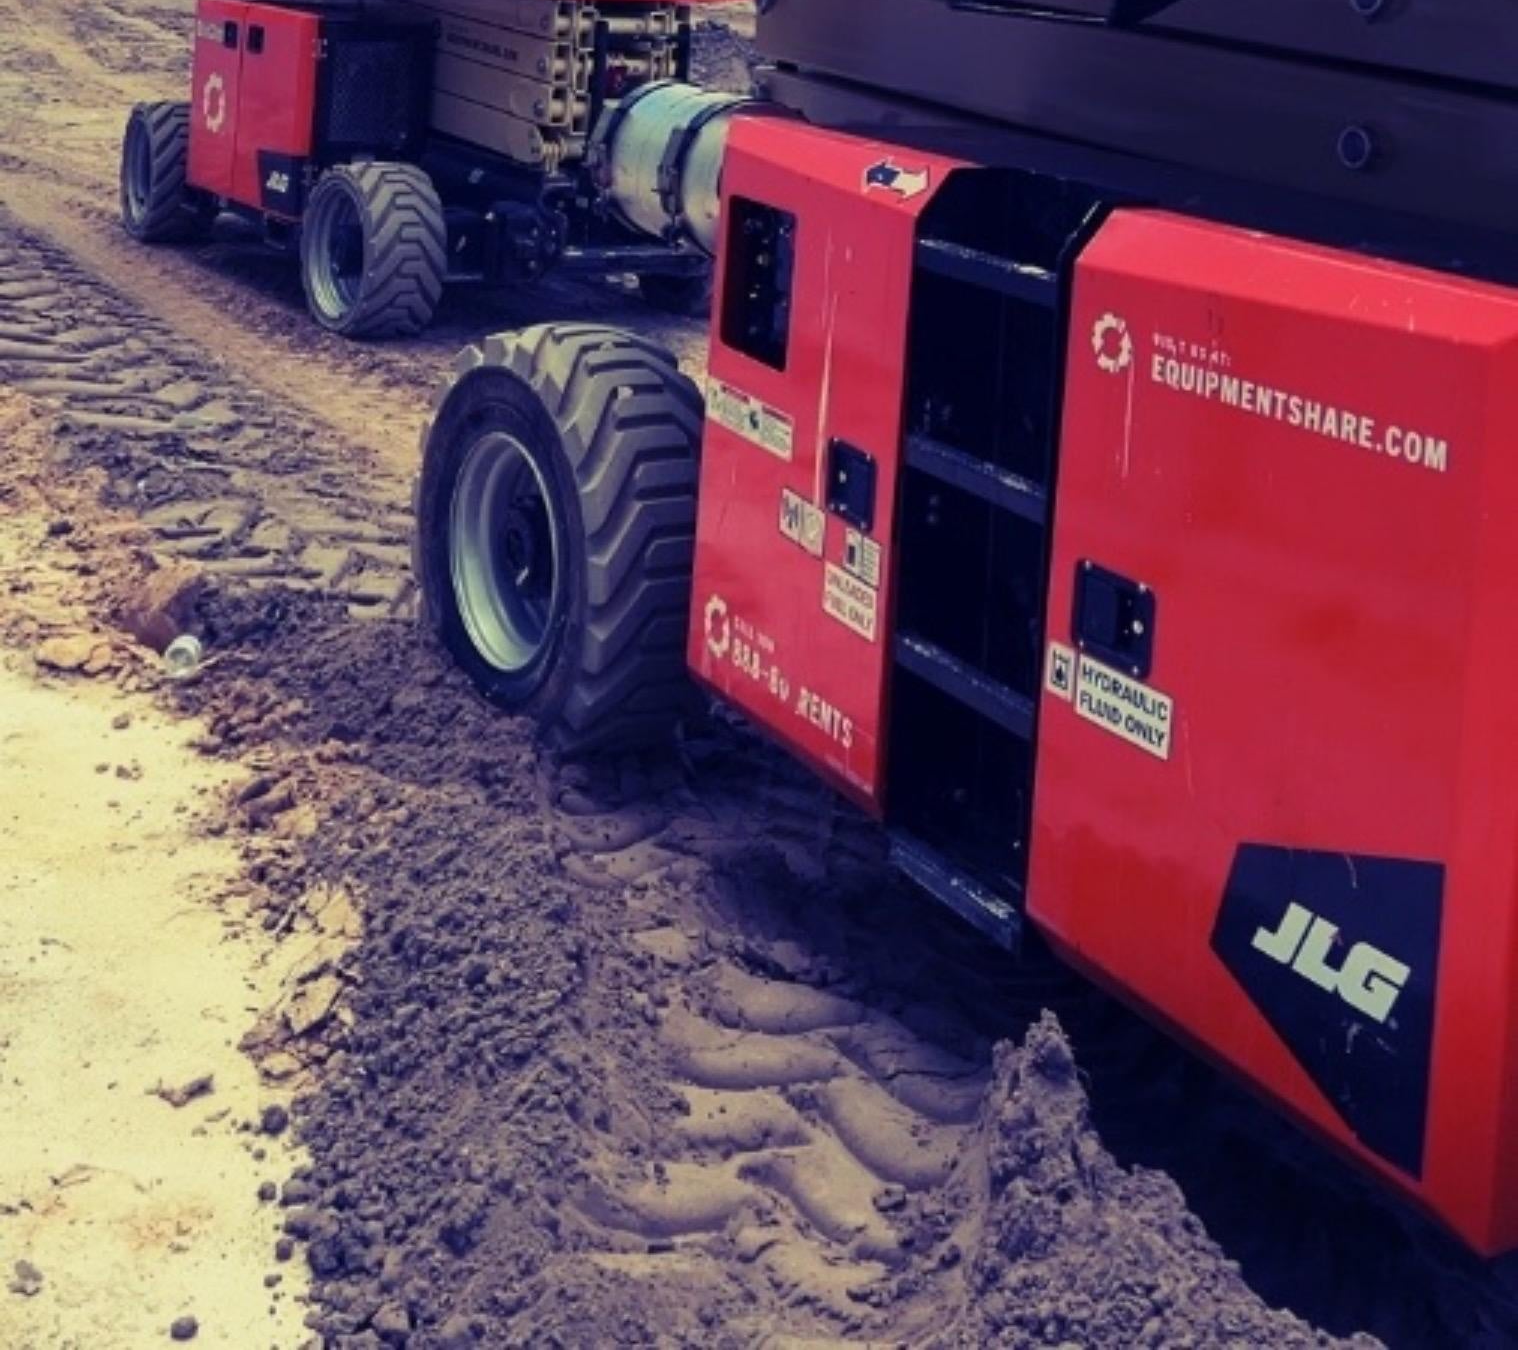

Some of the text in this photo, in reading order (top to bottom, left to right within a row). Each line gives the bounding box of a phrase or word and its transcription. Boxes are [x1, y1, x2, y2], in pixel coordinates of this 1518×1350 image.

[1151, 353, 1447, 472] EQUIPMENTSHARE.COM
[1080, 689, 1165, 748] FLUID ONLY
[1082, 661, 1168, 721] HYDRAULIC
[1251, 901, 1411, 1024] JLG
